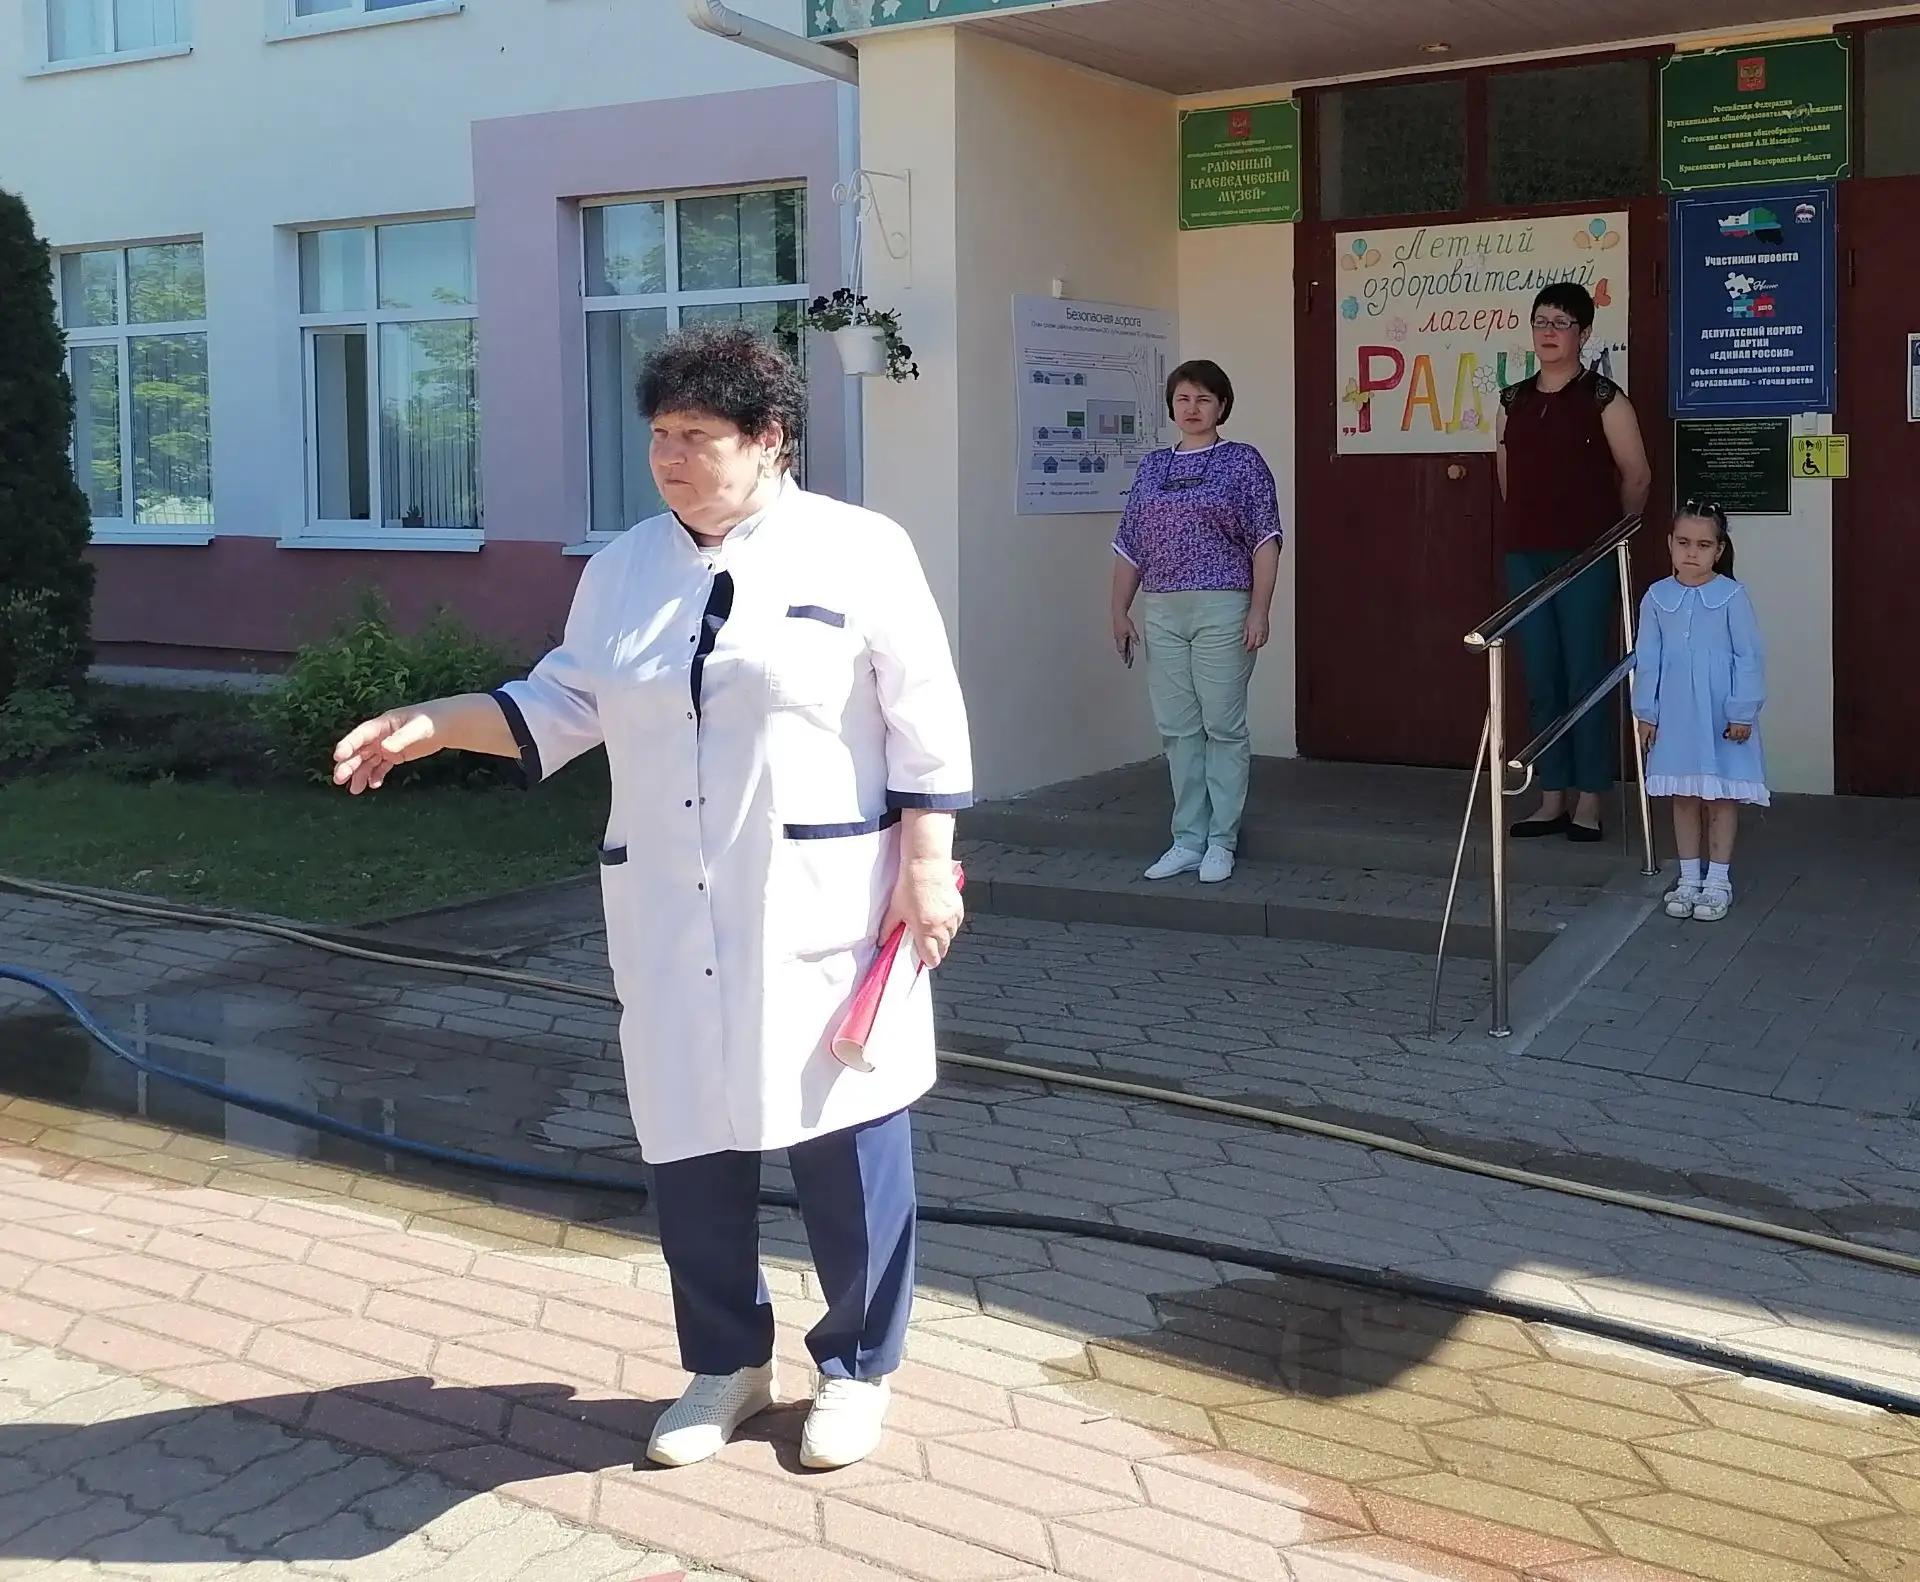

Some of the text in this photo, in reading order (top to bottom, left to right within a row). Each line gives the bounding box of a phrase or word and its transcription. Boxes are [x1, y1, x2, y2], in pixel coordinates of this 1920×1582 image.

[1753, 155, 1801, 166] Белгородской
[1190, 169, 1290, 190] КРАЕВЕДЧЕСКИЙ
[1218, 187, 1266, 204] МУЗЕЙ»
[1394, 226, 1536, 260] Летний
[1705, 252, 1799, 266] Участники проекта
[1363, 258, 1597, 317] оздоровительный
[1066, 307, 1142, 328] Безопасная дорога
[1418, 307, 1520, 341] лагерь
[1701, 325, 1803, 339] ДЕПУТАТСКИЙ КОРПУС
[1734, 338, 1769, 348] ПАРТИИ
[1710, 348, 1794, 361] «ЕДИНАЯ РОССИЯ»
[1719, 366, 1780, 375] национального
[1781, 365, 1815, 373] проекта
[1691, 378, 1750, 388] «ОБРАЗОВАНИЕ»
